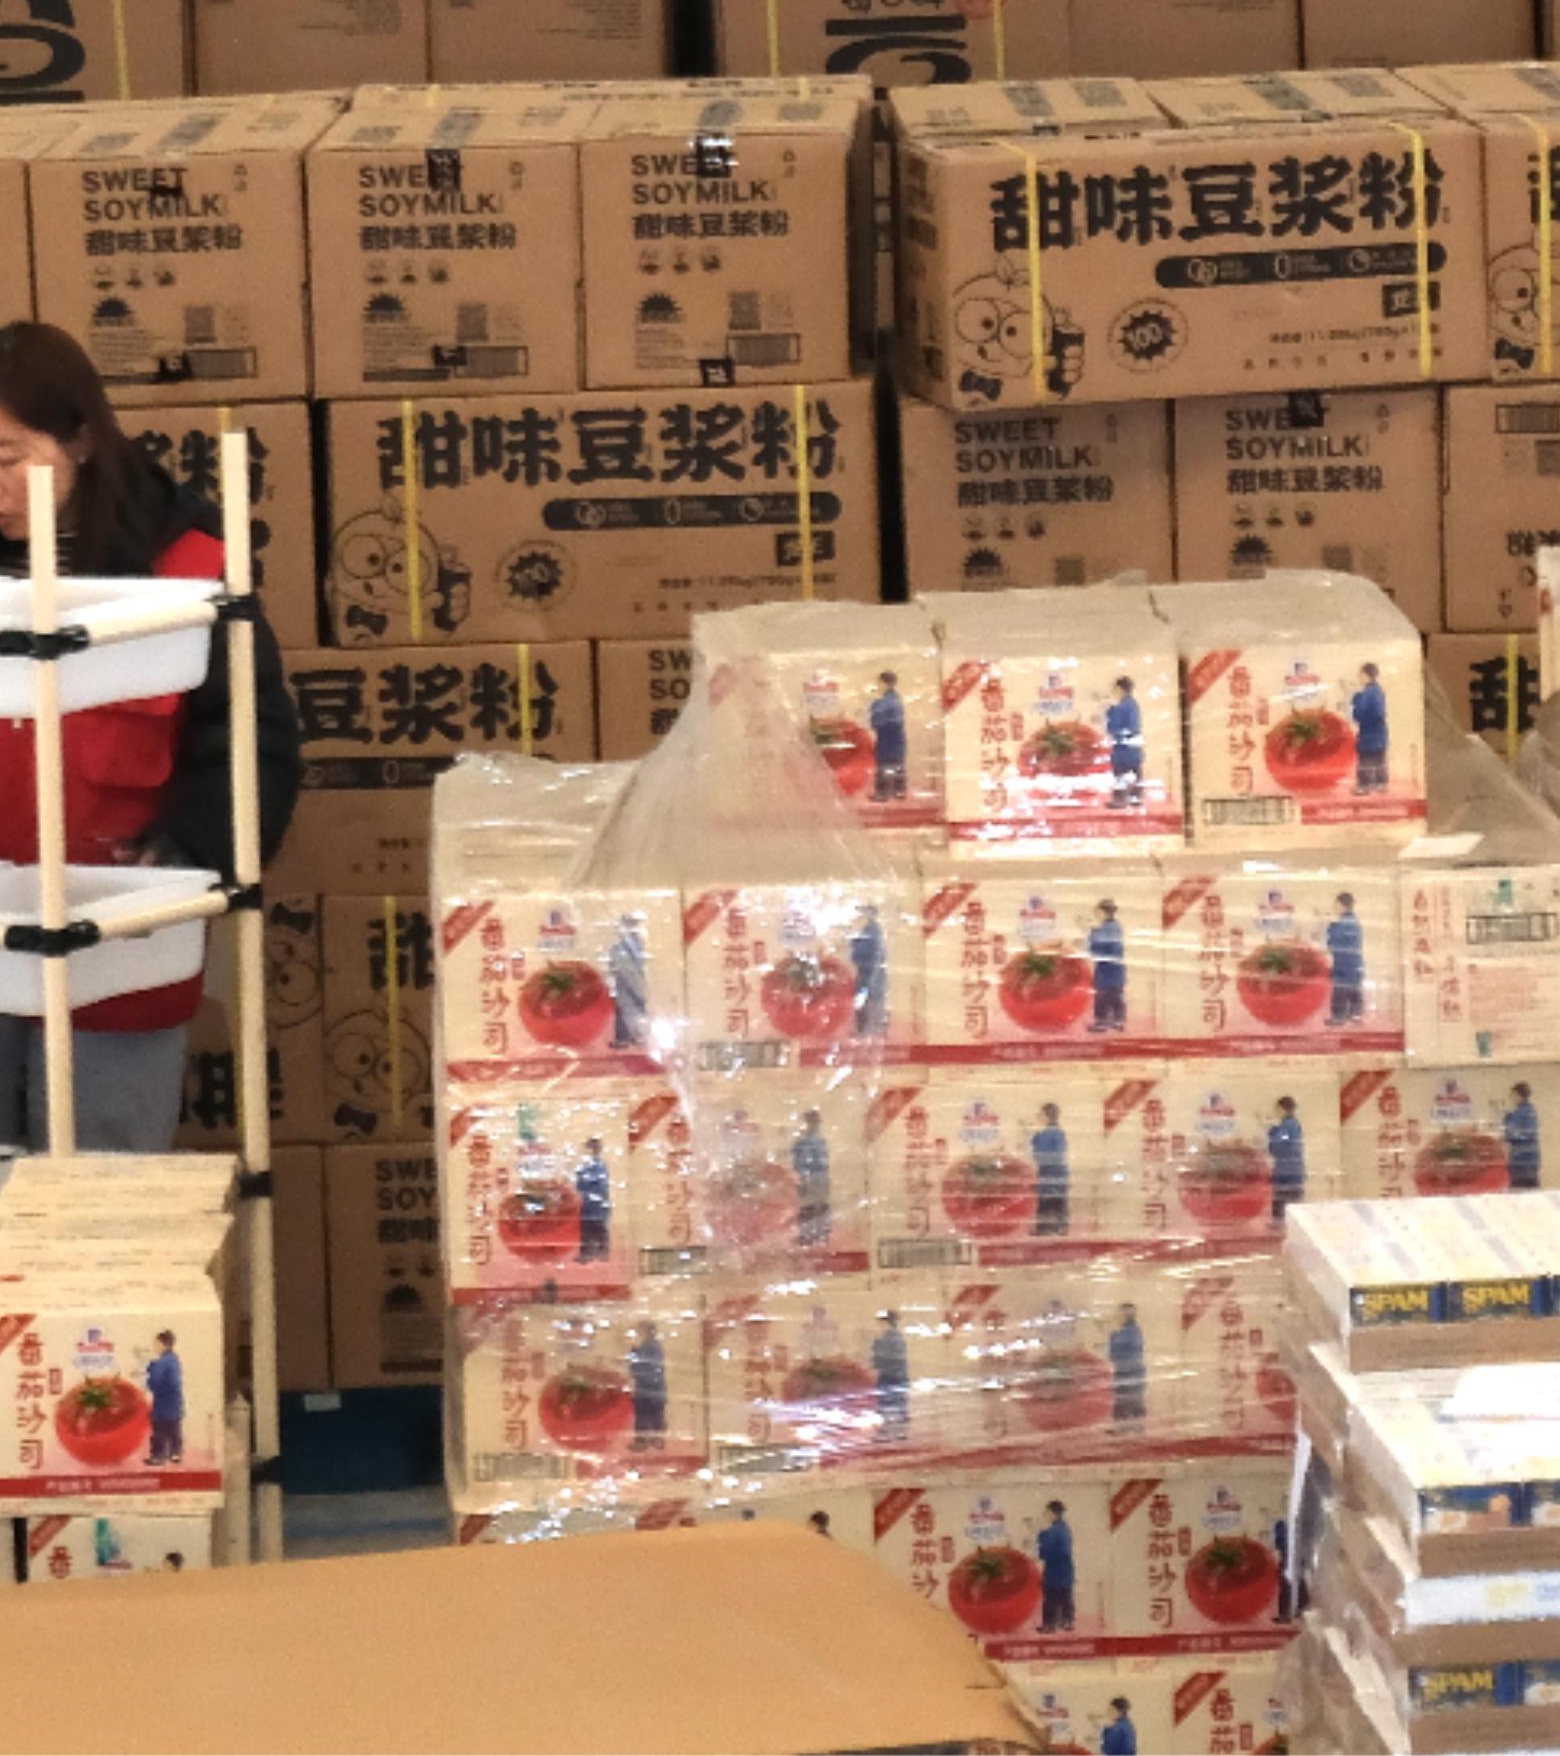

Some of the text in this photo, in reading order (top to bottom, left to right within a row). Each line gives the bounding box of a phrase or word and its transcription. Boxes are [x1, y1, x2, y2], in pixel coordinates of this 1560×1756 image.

[83, 192, 221, 220] SOYMILK
[359, 191, 496, 218] SOYMILK
[632, 180, 770, 206] SOYMILK
[990, 151, 1447, 252] 甜味豆浆粉
[86, 225, 242, 256] 甜味豆浆粉
[360, 223, 516, 251] 甜味豆浆粉
[633, 211, 790, 240] 甜味豆浆粉
[374, 400, 841, 492] 甜味豆浆粉
[952, 416, 1061, 447] SWEET
[954, 445, 1093, 475] SOYMILK
[1225, 433, 1365, 461] SOYMILK
[956, 473, 1114, 507] 甜味豆浆粉
[1226, 466, 1384, 496] 甜味豆浆粉
[1227, 664, 1254, 796] 番茄沙司
[1362, 1289, 1431, 1317] SPAM
[1461, 1282, 1531, 1311] SPAM
[16, 1335, 46, 1473] 番茄沙司
[1146, 1493, 1178, 1627] 番茄沙司
[1422, 1670, 1496, 1702] SPAM
